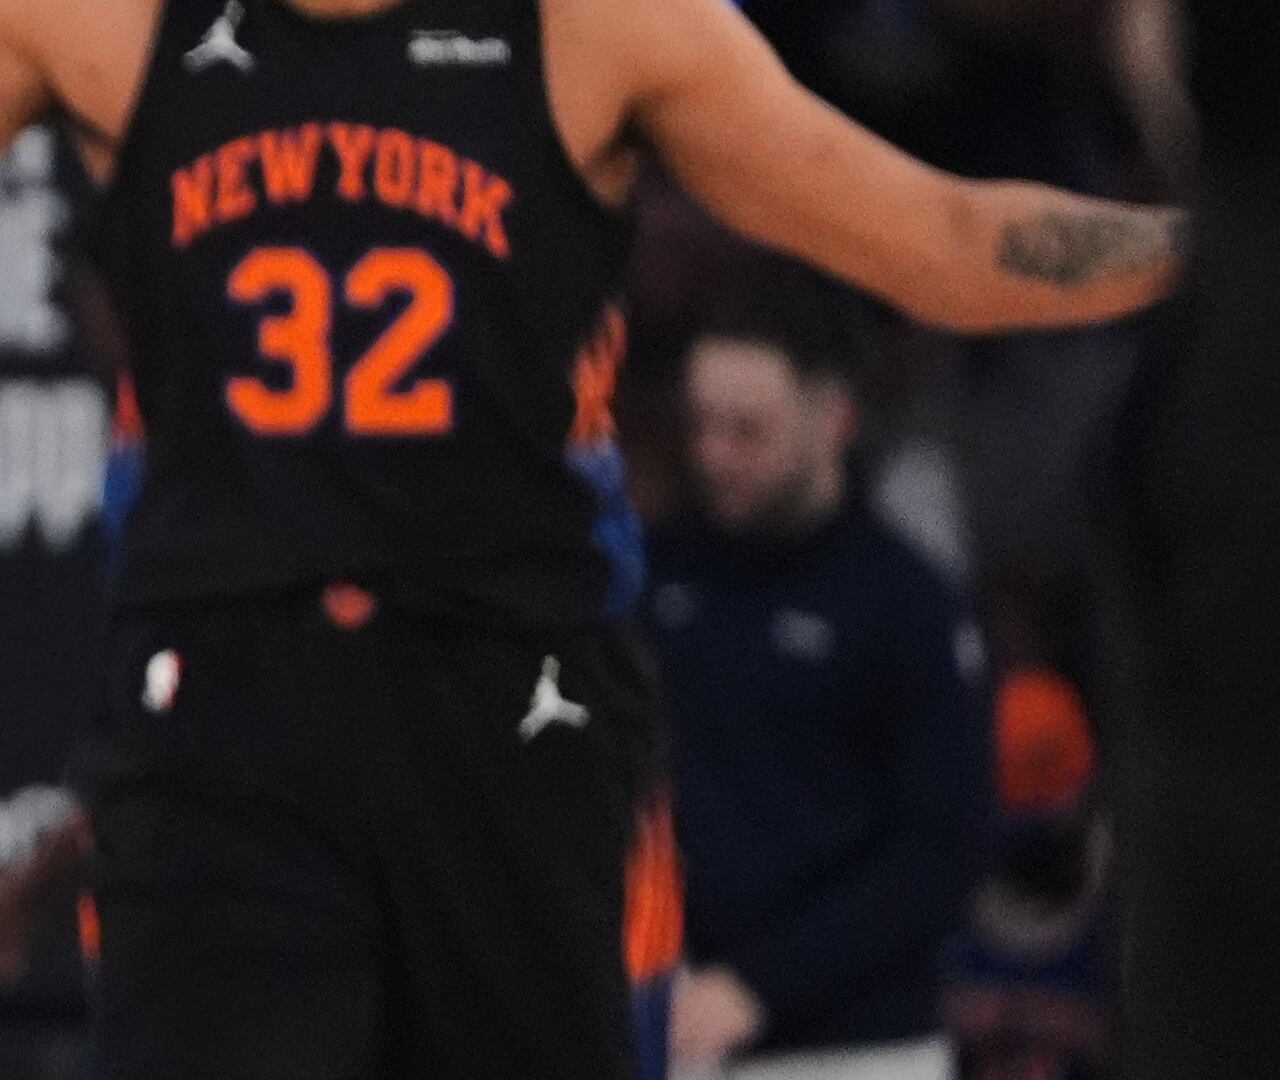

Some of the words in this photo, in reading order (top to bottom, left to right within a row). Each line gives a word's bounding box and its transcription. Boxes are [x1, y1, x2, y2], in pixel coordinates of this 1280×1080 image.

[170, 121, 322, 249] NEW
[328, 121, 516, 262] YORK
[227, 245, 456, 435] 32
